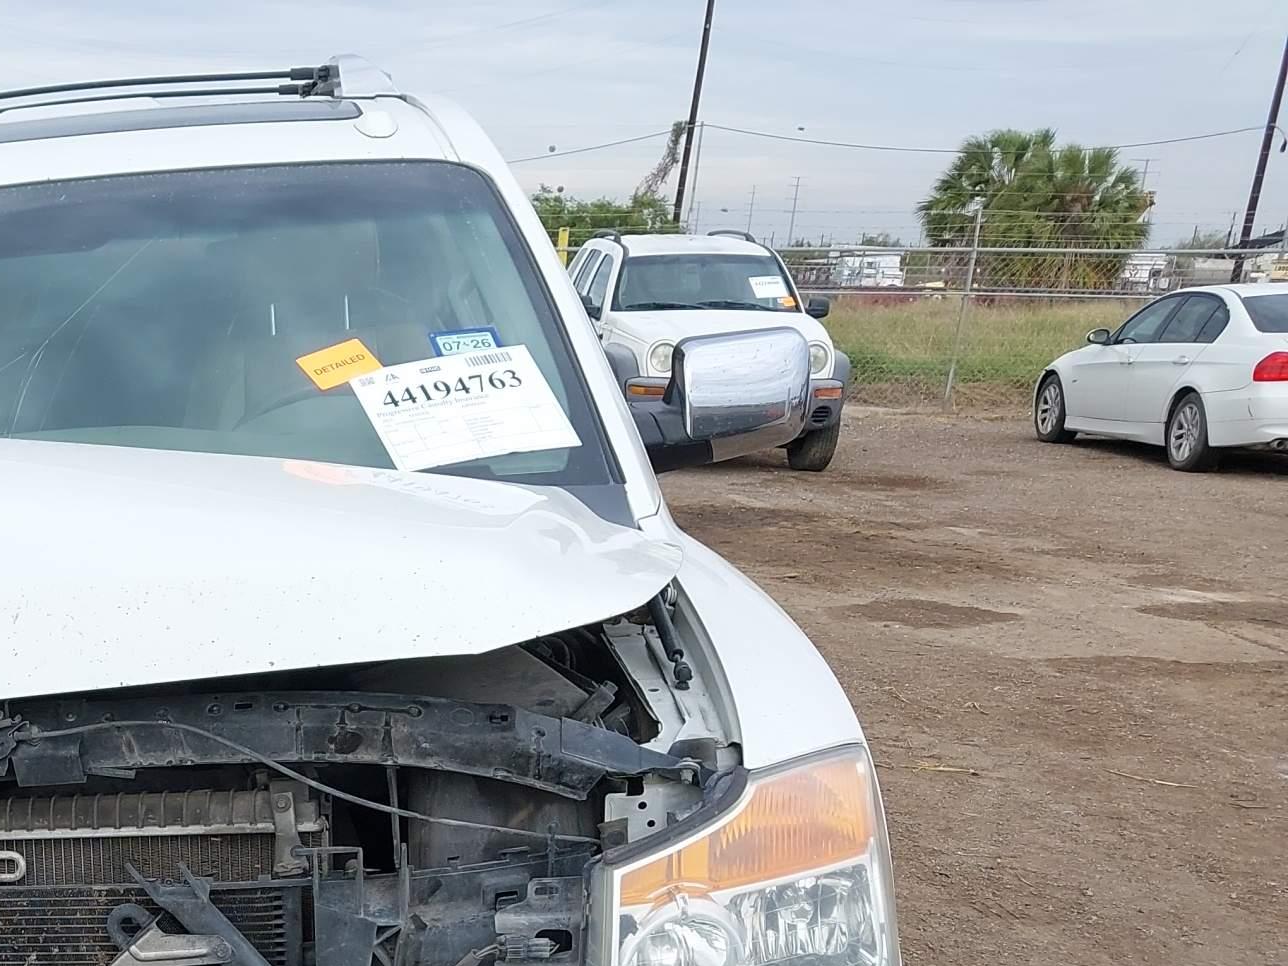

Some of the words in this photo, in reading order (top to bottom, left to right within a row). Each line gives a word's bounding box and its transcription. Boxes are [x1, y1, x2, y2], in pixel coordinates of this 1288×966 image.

[443, 341, 461, 351] 07
[471, 339, 492, 348] 26
[314, 353, 366, 376] DETAILED
[383, 370, 522, 407] 44194763
